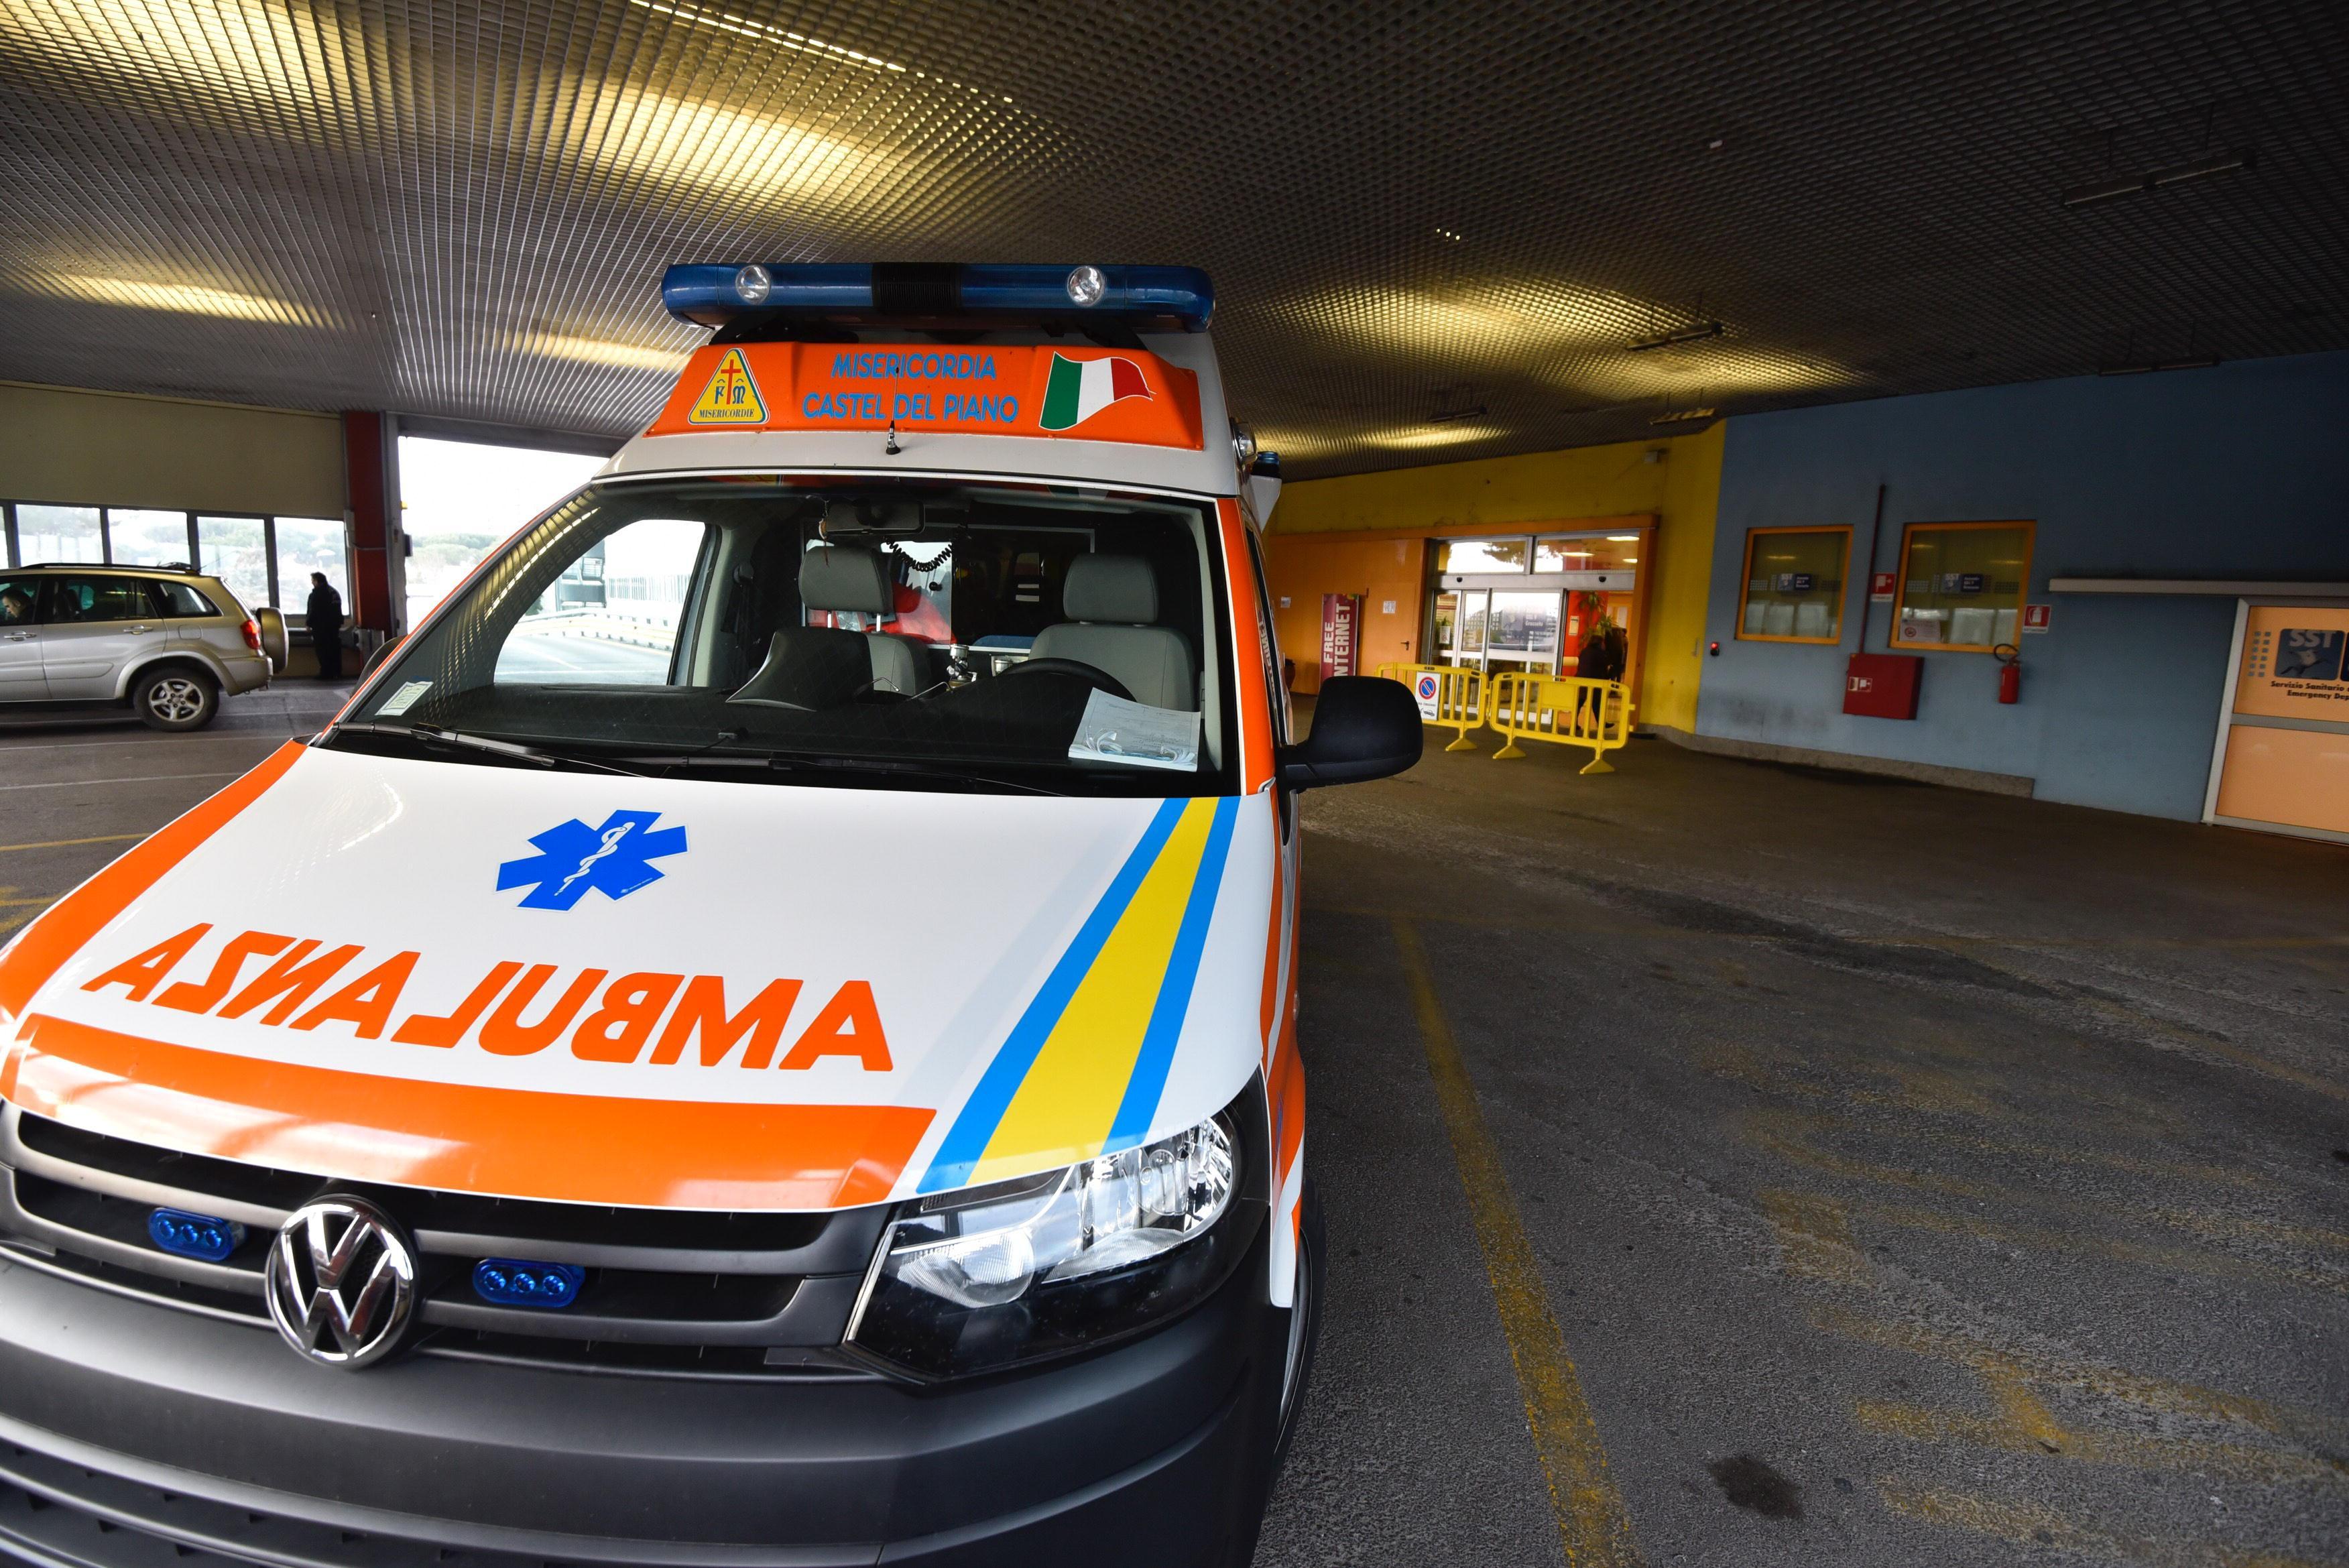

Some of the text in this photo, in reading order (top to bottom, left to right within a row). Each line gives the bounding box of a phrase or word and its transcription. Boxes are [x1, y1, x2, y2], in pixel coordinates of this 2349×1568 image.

[831, 353, 996, 380] MISERICORDIA
[699, 408, 755, 418] MISERICORDIE
[802, 392, 1019, 423] CASTEL DEL PIANO
[1323, 621, 1334, 664] FREE
[1334, 603, 1351, 677] NTERNET
[2289, 629, 2337, 648] SST
[2271, 680, 2303, 689] Servizio
[2305, 682, 2345, 692] Sanitario
[2287, 690, 2332, 700] Emergency
